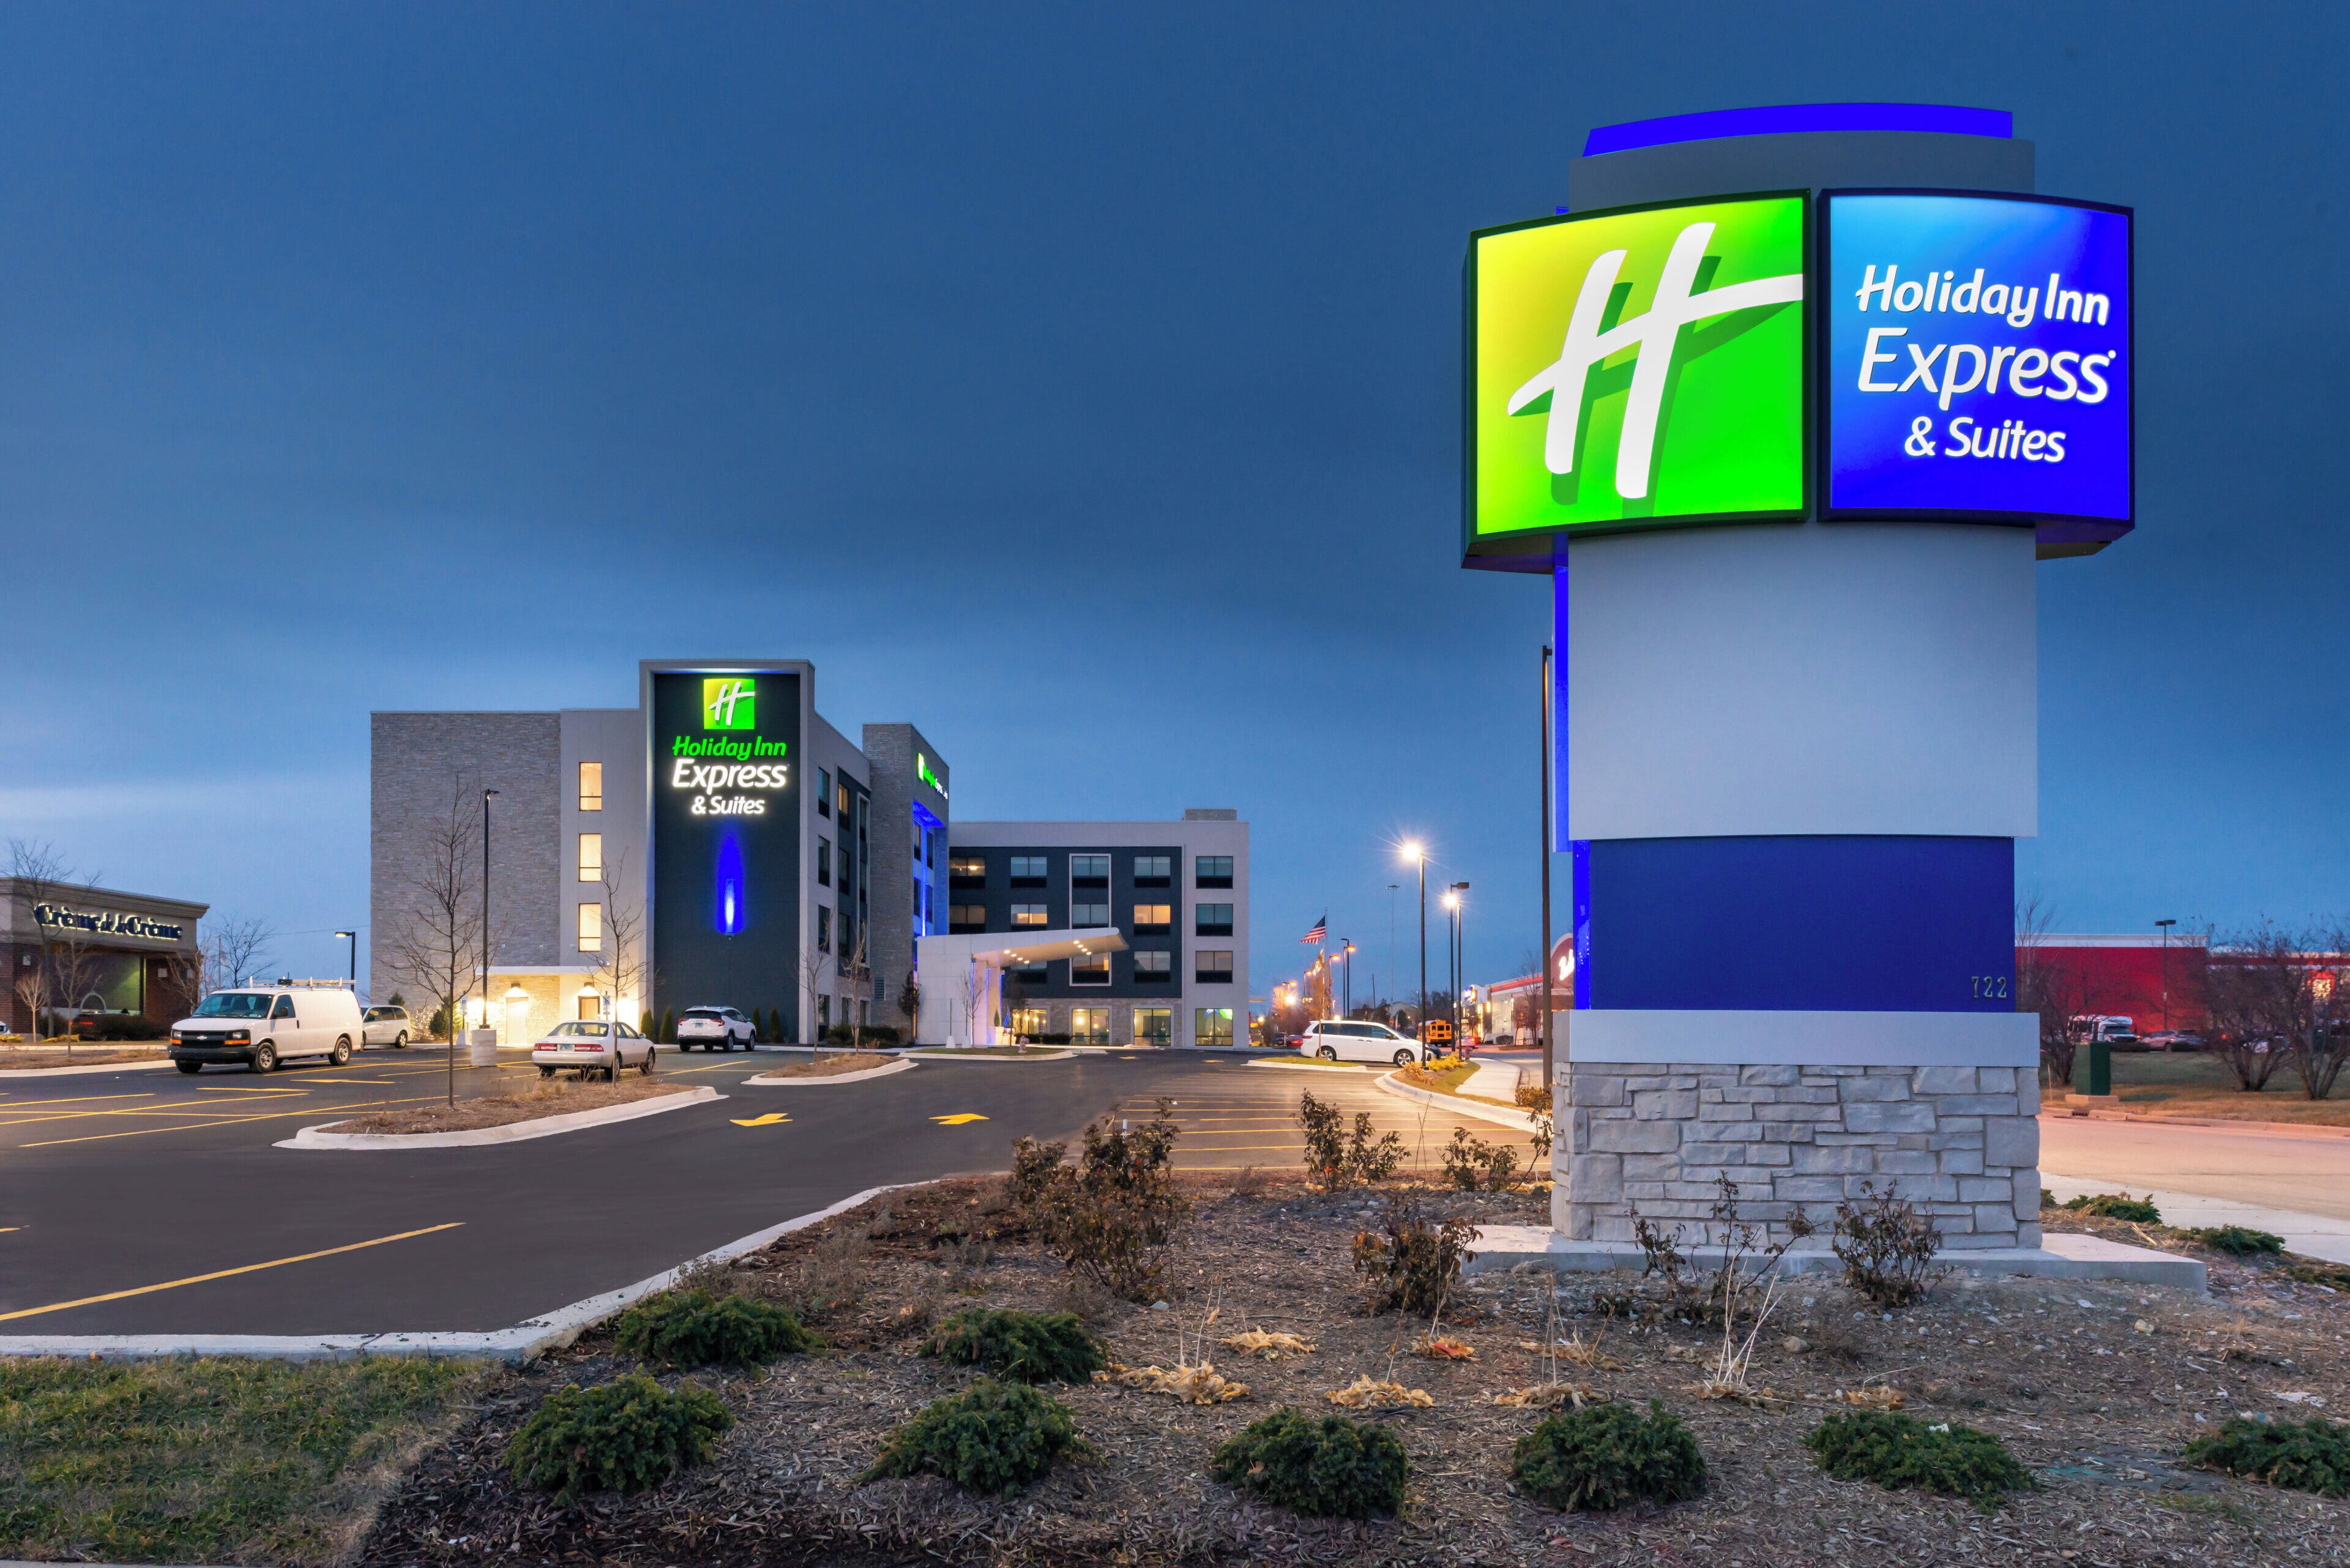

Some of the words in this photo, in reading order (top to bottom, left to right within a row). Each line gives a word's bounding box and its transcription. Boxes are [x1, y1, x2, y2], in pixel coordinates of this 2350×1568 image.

[1855, 264, 2039, 329] Holiday
[2043, 273, 2109, 326] Inn
[1857, 327, 2111, 411] Express
[1904, 415, 1938, 457] &
[1945, 416, 2067, 463] Suites
[673, 736, 752, 761] Holiday
[754, 736, 786, 756] Inn
[672, 758, 788, 796] Express
[691, 796, 706, 815] &
[709, 796, 766, 815] Suites
[1971, 976, 2007, 998] 722
